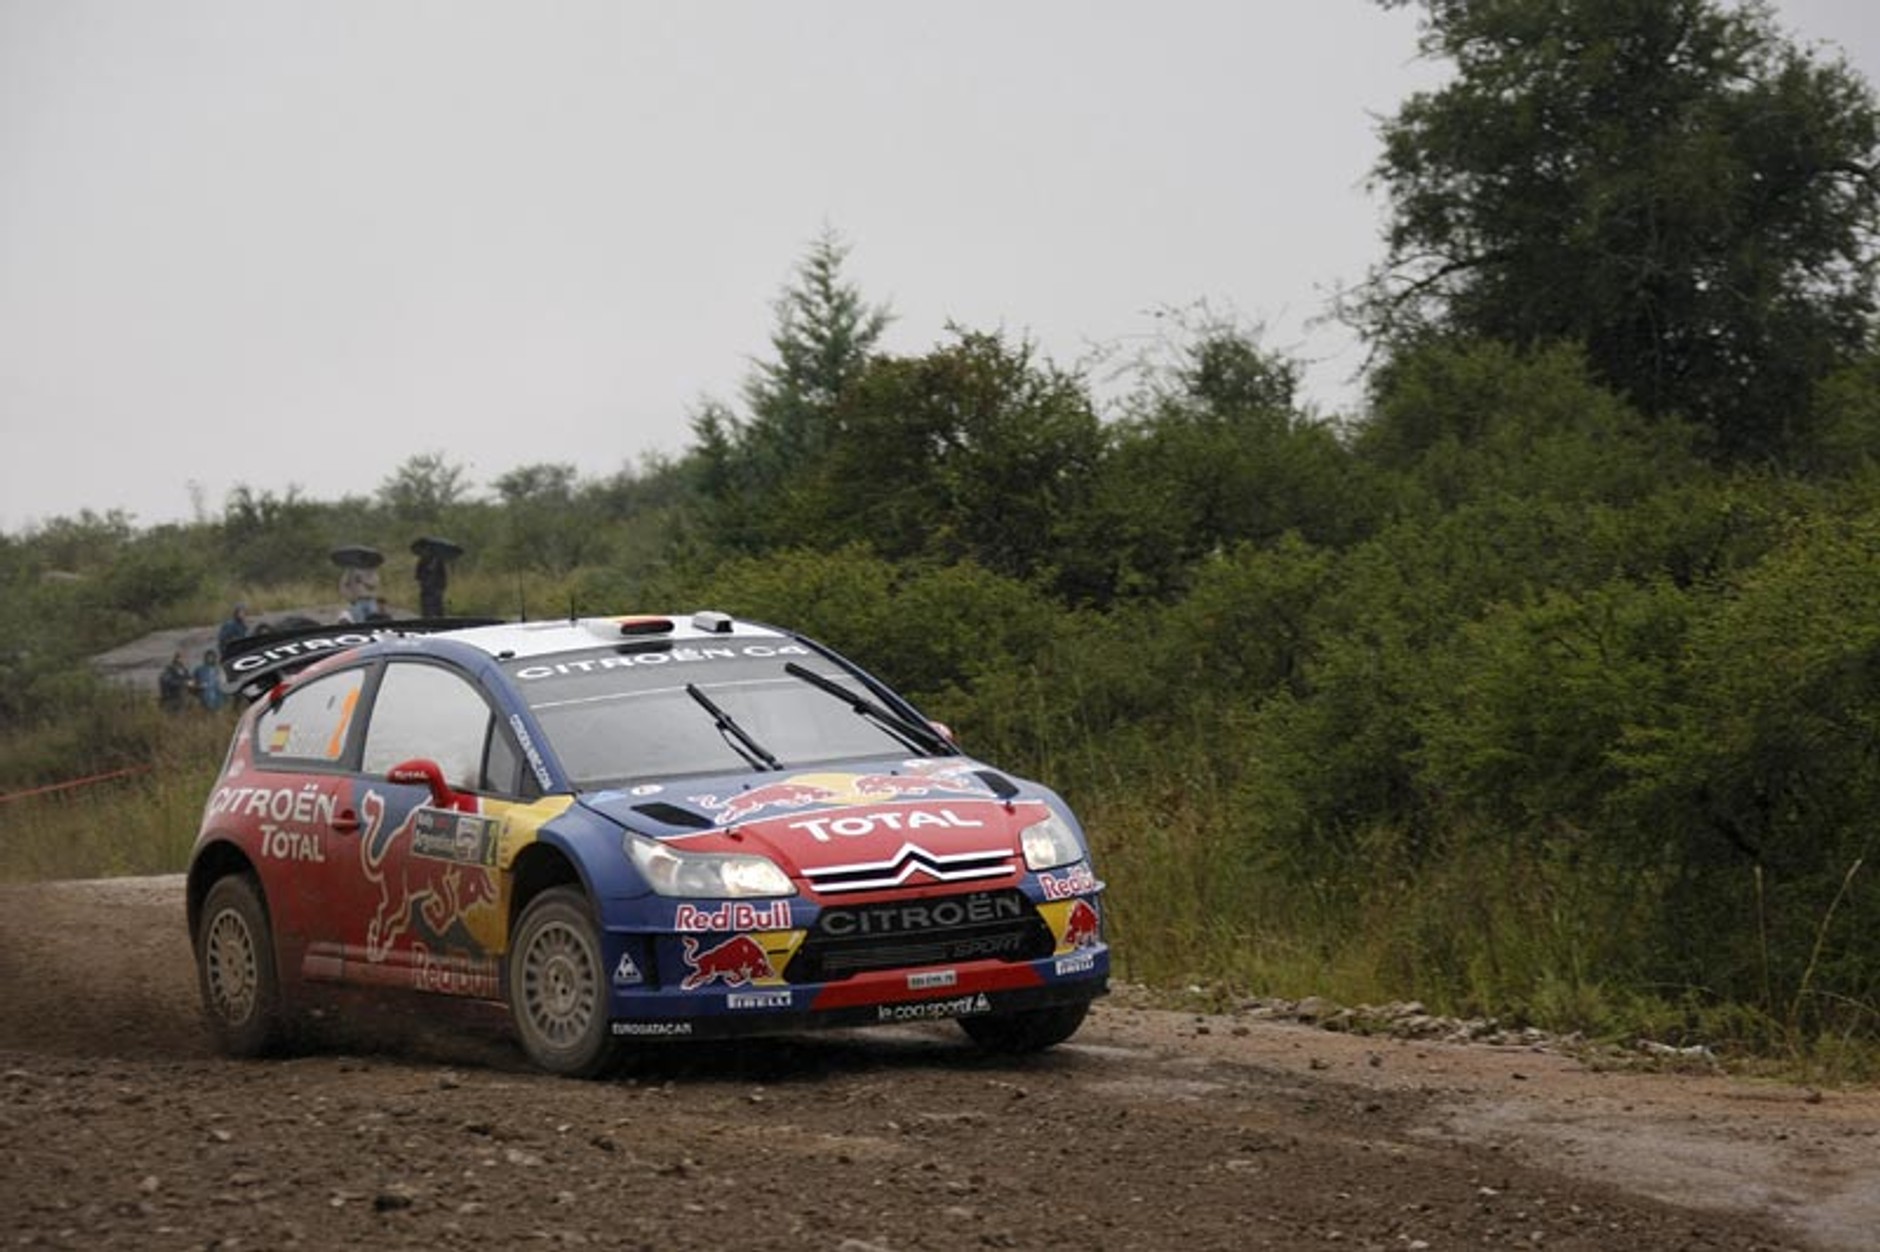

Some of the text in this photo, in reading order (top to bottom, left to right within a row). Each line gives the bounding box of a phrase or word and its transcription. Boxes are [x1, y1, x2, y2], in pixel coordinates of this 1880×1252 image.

[516, 645, 810, 679] CITROËN C4
[208, 783, 338, 825] CITROËN
[787, 808, 985, 842] TOTAL
[259, 823, 326, 863] TOTAL
[1037, 867, 1081, 901] Red
[675, 900, 792, 931] Red Bull
[820, 893, 1022, 935] CITROËN
[727, 991, 791, 1009] PIRELLI
